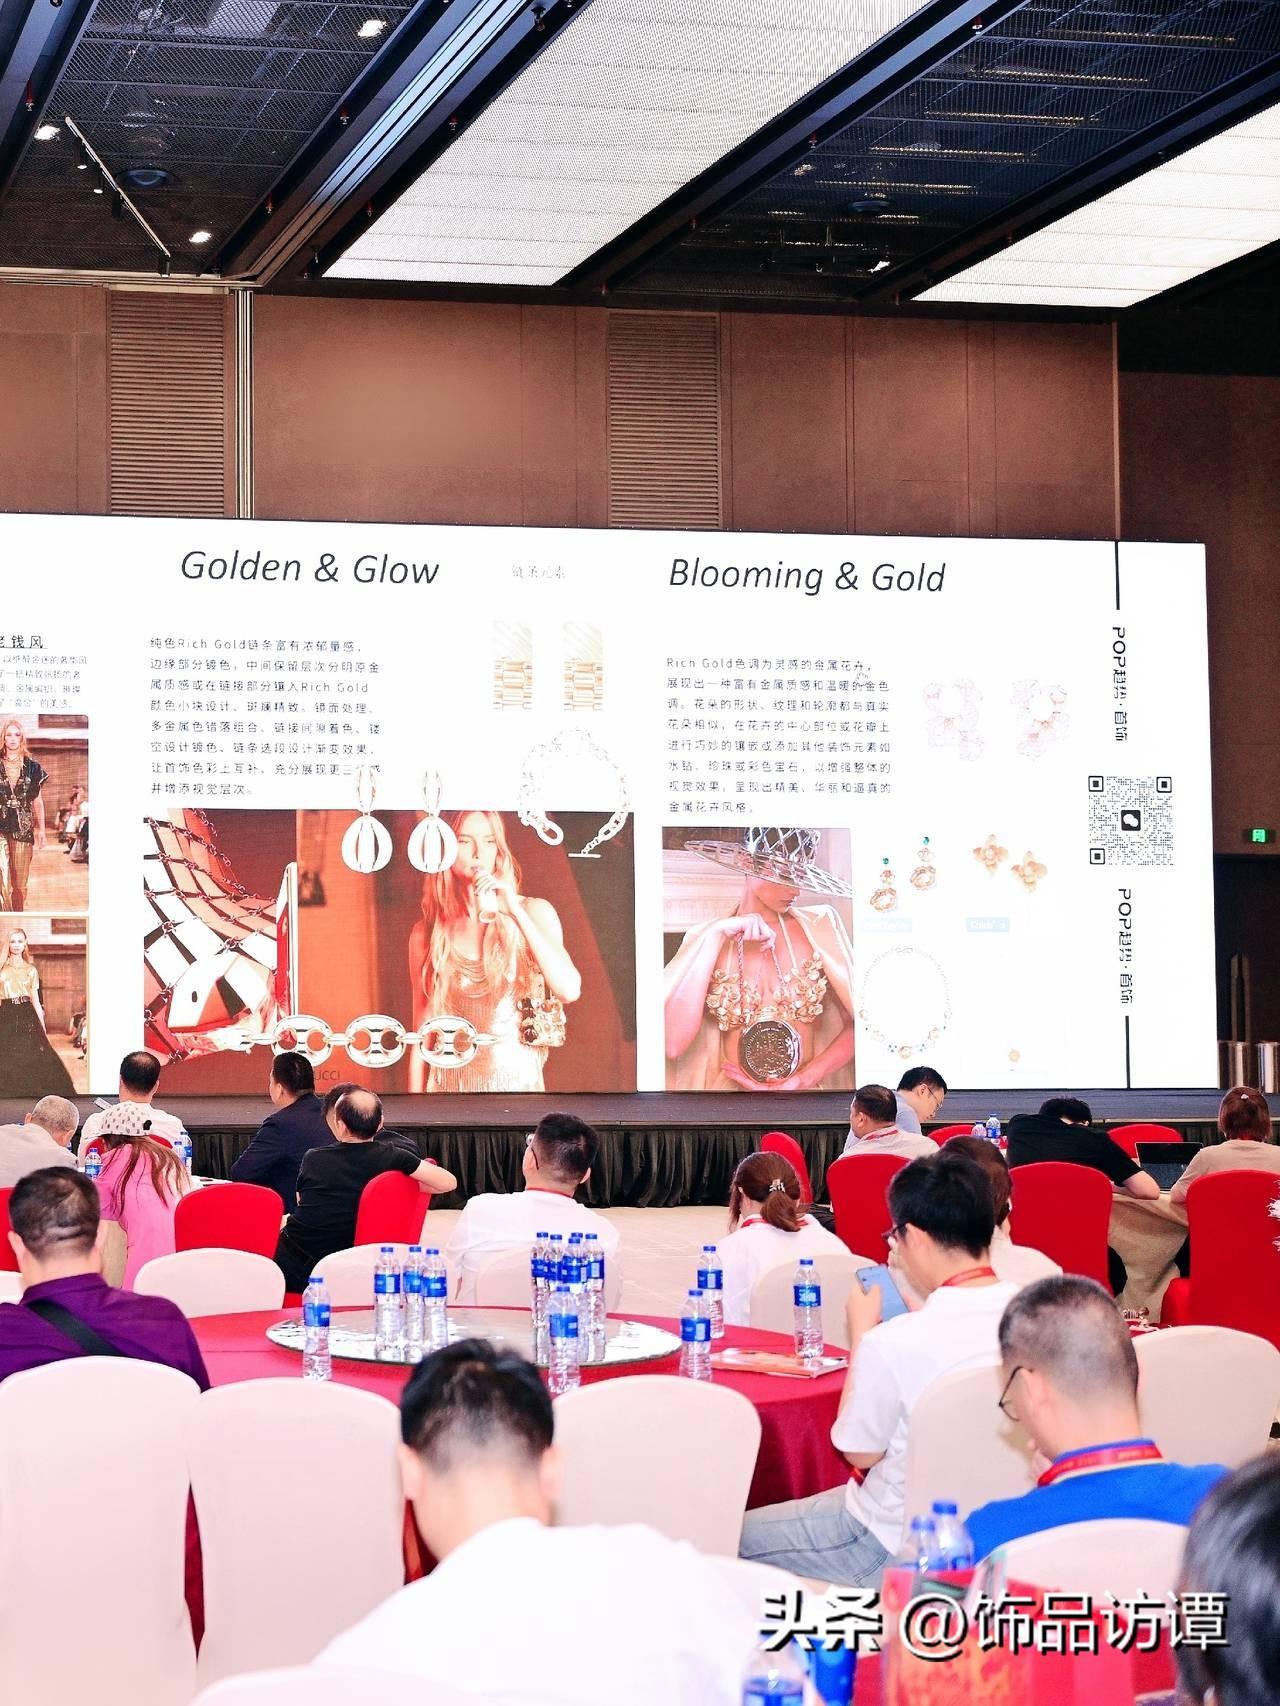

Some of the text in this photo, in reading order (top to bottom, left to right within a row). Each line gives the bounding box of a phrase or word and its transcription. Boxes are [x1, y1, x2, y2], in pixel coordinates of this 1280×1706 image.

[182, 550, 439, 583] Golden & Glow
[670, 558, 945, 596] Blooming & Gold
[667, 658, 695, 667] Rich
[314, 1070, 340, 1081] UCCI
